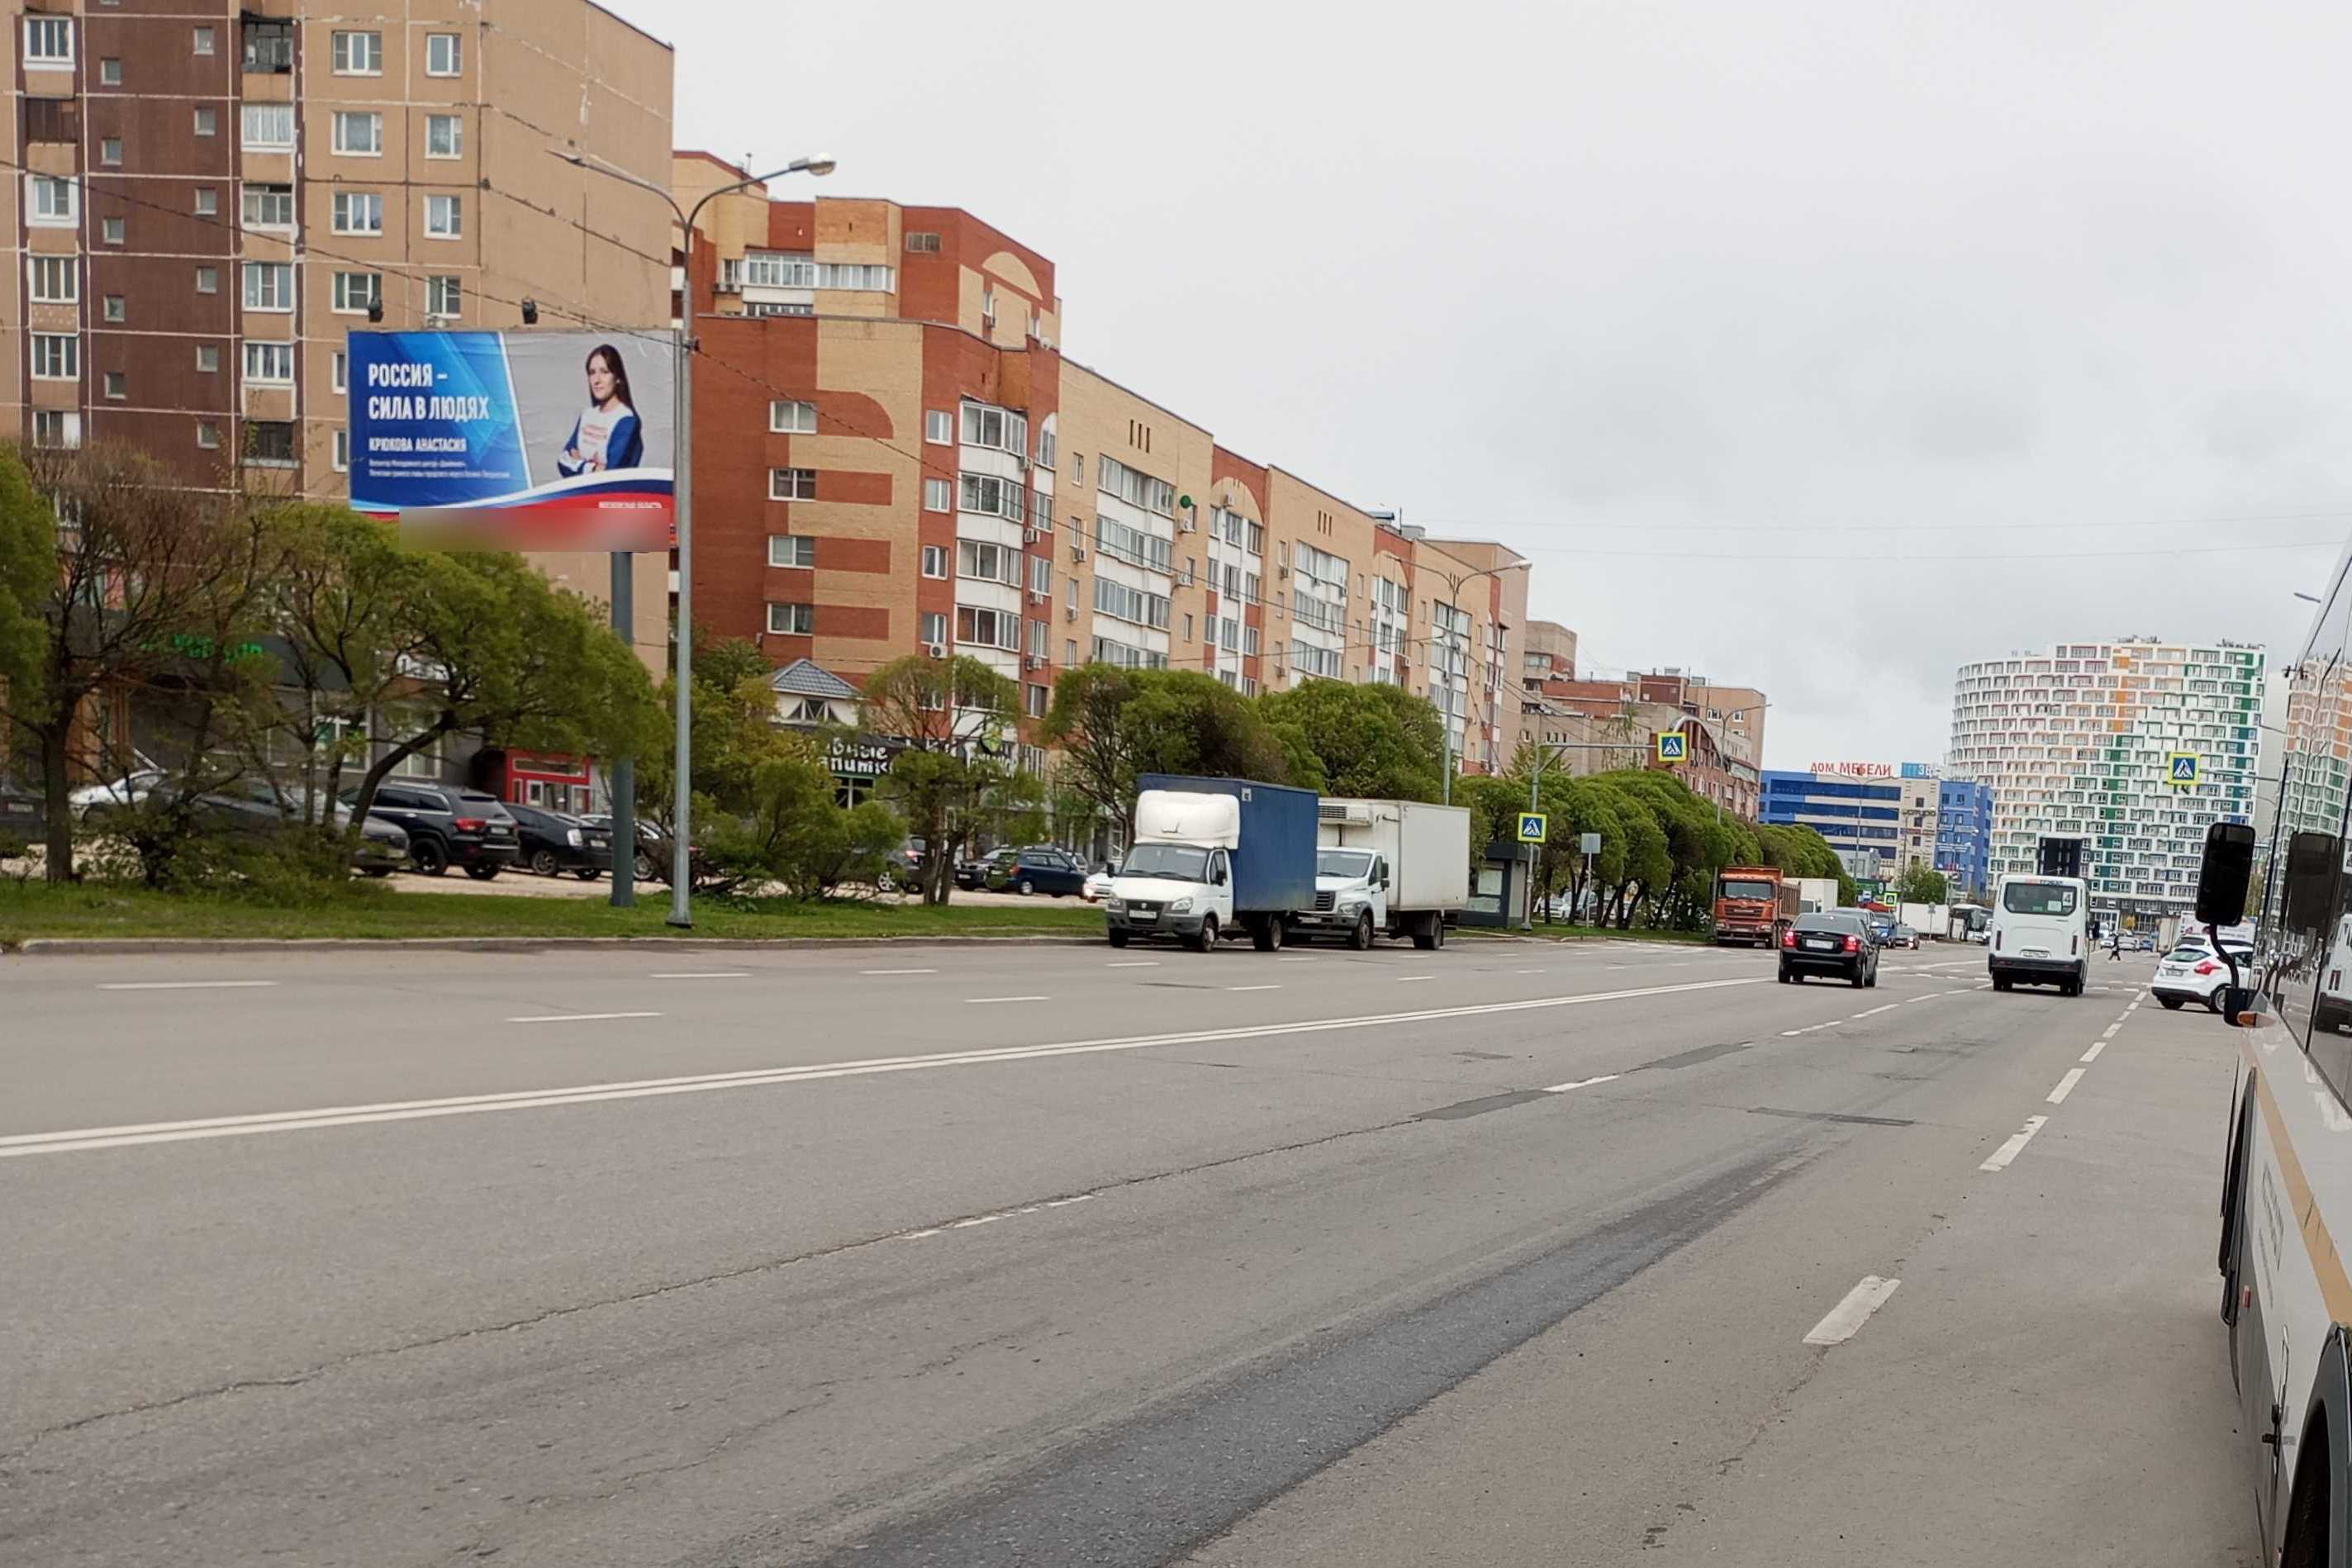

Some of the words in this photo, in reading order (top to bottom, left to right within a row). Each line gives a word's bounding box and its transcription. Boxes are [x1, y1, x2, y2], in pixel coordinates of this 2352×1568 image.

[368, 363, 433, 387] РОССИЯ
[368, 396, 413, 421] СИЛА
[415, 397, 426, 420] В
[428, 397, 490, 423] ЛЮДЯХ
[1811, 762, 1836, 775] ДОМ
[1839, 762, 1891, 778] МЕБЕЛИ
